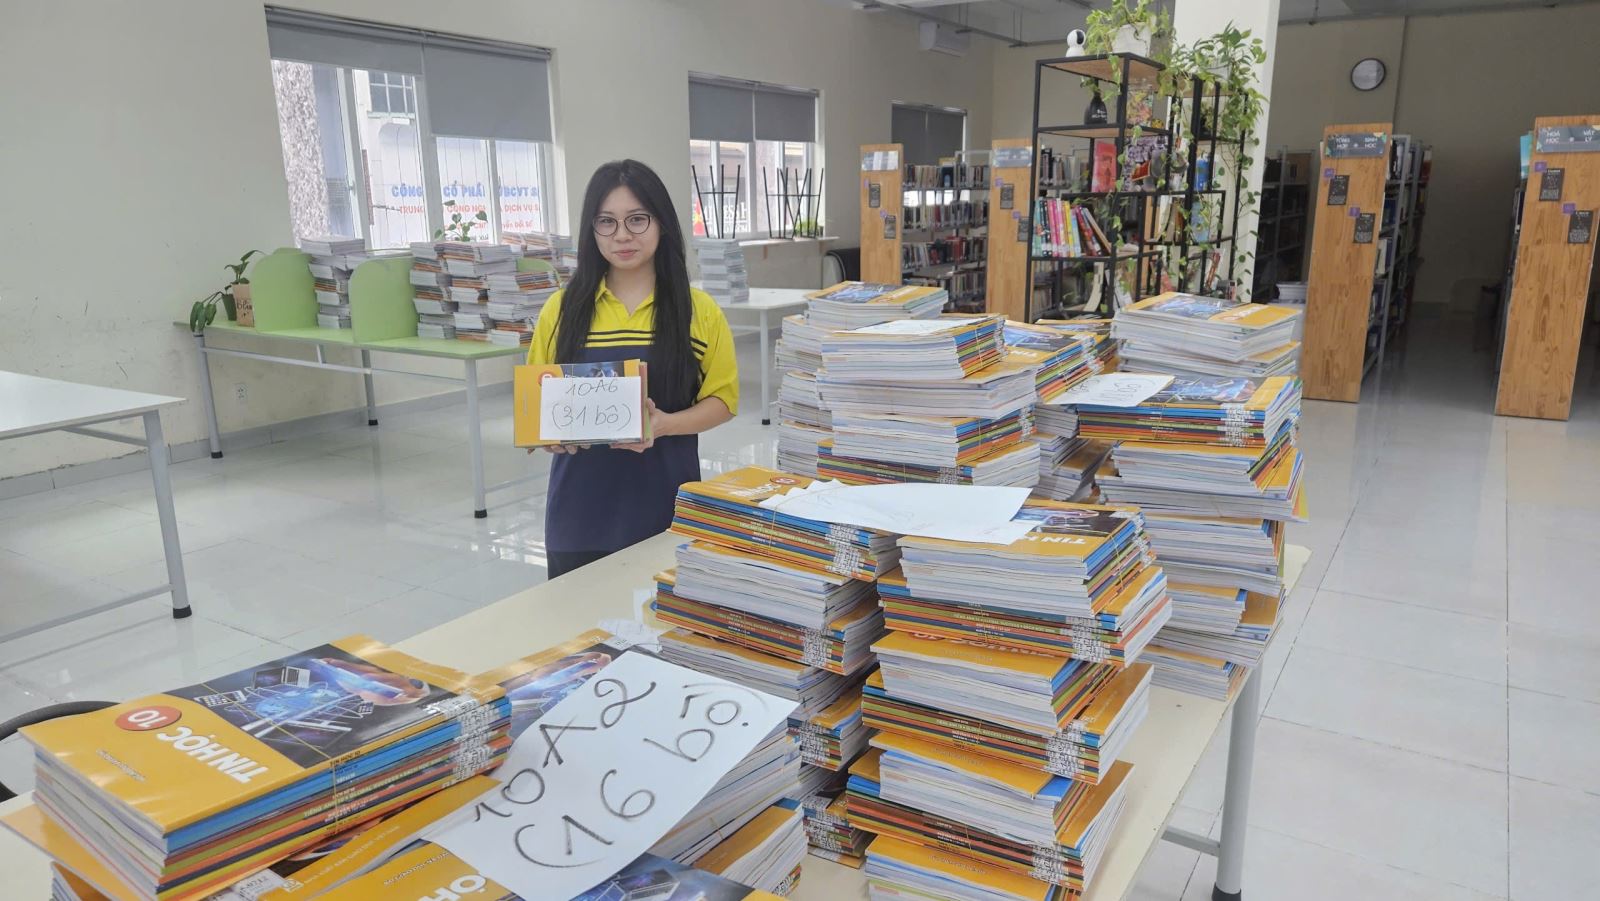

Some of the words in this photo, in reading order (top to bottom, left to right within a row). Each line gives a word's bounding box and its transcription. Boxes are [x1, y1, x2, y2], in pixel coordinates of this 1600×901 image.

[391, 183, 423, 198] CÔNG
[443, 180, 458, 198] CỔ
[462, 182, 485, 198] PHẦ
[552, 403, 586, 430] (31
[127, 709, 168, 728] 10
[156, 725, 231, 762] HỌC
[475, 678, 656, 822] 10A2
[207, 752, 268, 784] TIN
[514, 769, 656, 868] (16
